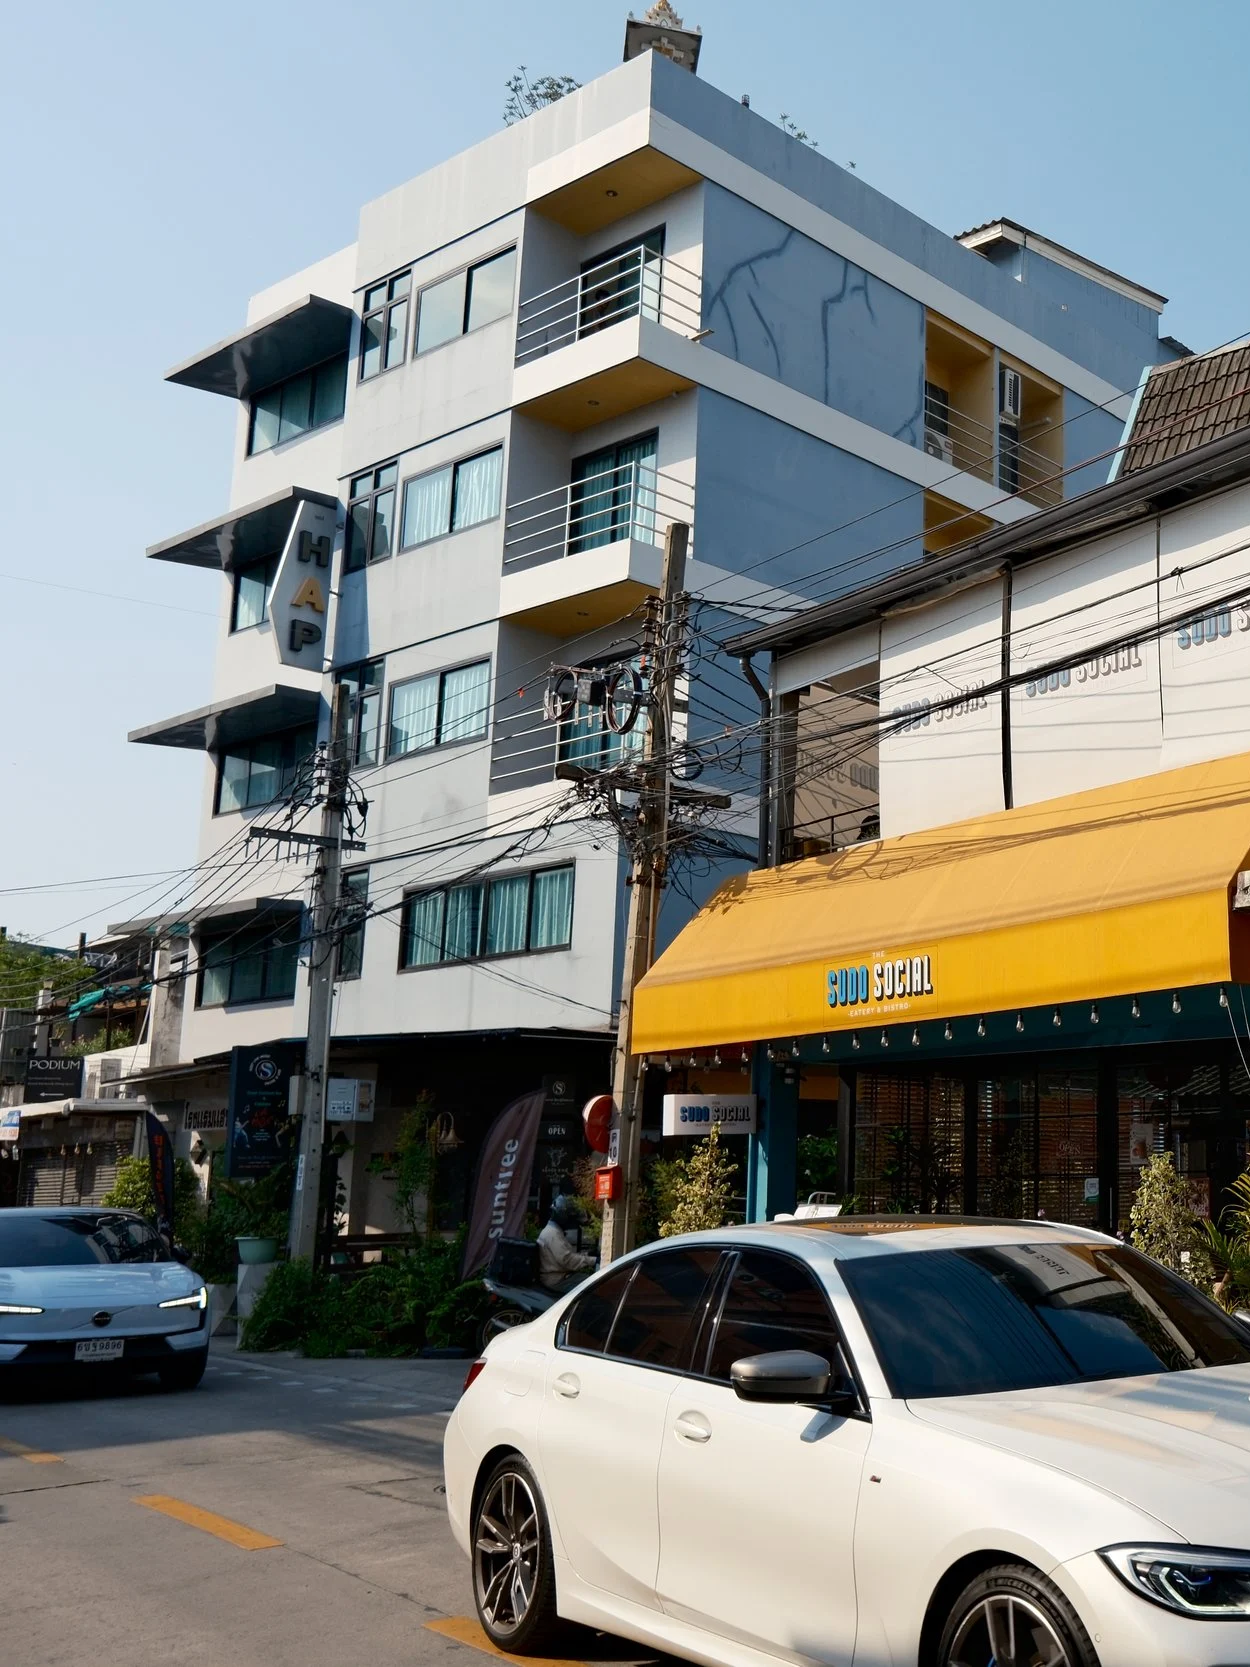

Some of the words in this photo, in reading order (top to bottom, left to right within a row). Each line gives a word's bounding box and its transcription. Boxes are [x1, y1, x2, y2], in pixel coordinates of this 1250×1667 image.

[872, 950, 885, 958] THE
[827, 965, 869, 1008] SUDO
[873, 955, 933, 1001] SOCIAL
[29, 1059, 81, 1070] PODIUM
[680, 1106, 710, 1122] SUDO
[712, 1105, 751, 1122] SOCIAL
[548, 1125, 566, 1136] OPEN
